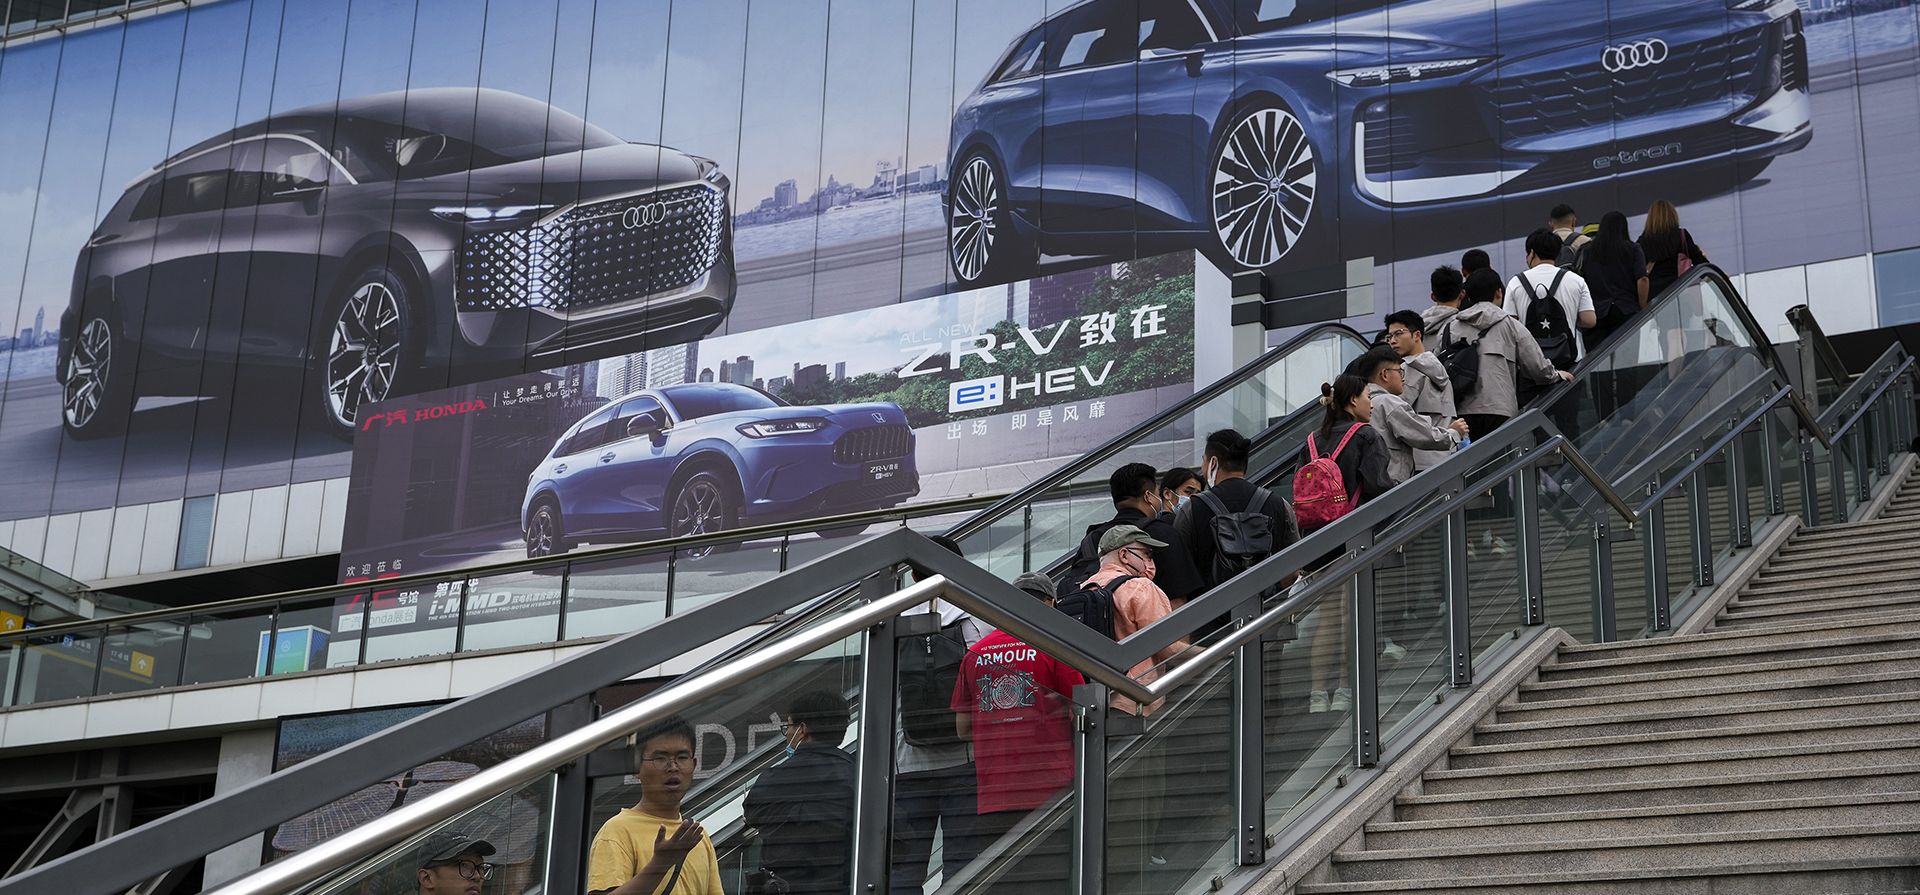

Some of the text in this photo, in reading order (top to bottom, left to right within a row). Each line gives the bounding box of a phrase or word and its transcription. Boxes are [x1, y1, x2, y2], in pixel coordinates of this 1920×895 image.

[1593, 142, 1682, 169] e-tron
[899, 323, 977, 345] ALL NEW
[546, 391, 559, 399] Our
[361, 400, 488, 432] 广汽 HONDA
[346, 559, 402, 577] 欢迎莅临
[974, 649, 1037, 668] ARMOUR
